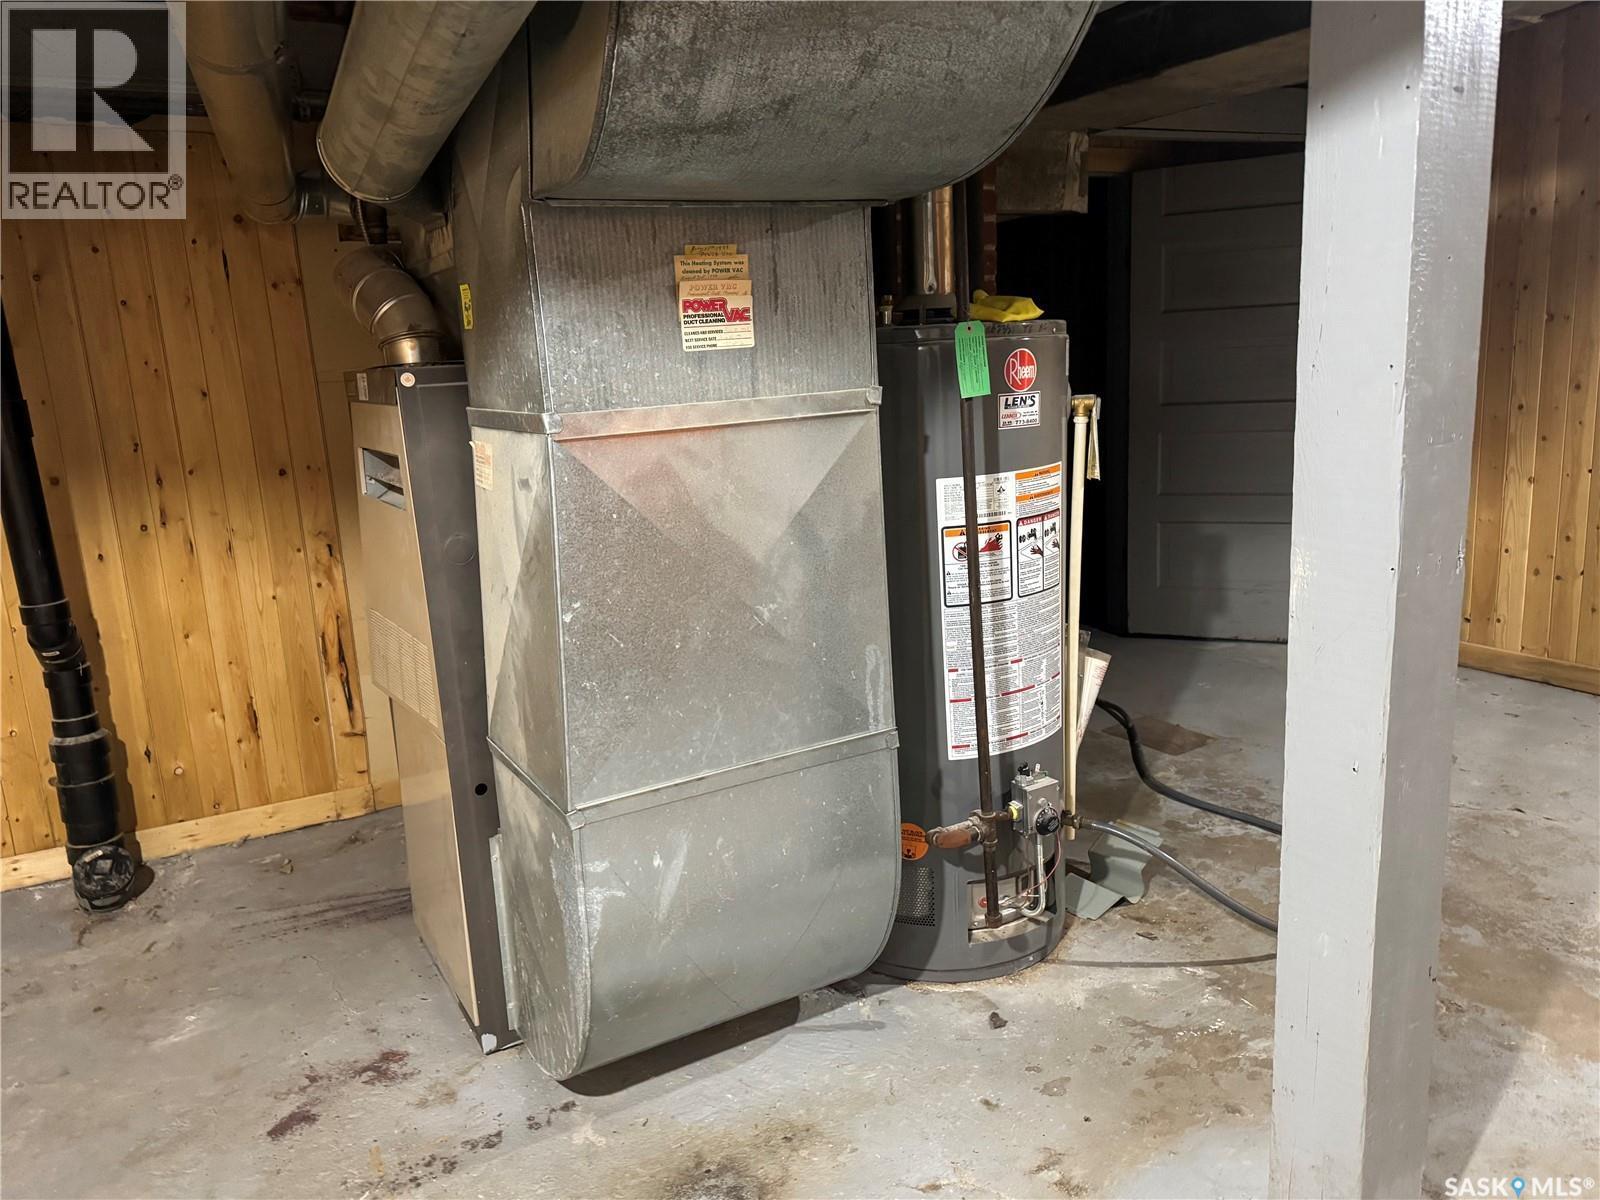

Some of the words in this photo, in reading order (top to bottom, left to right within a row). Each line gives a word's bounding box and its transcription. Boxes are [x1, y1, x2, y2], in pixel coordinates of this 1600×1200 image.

[691, 260, 712, 268] Heating
[713, 259, 732, 267] System
[682, 267, 702, 275] cleaned
[703, 267, 711, 275] by
[682, 297, 726, 314] POWER
[724, 306, 752, 322] VAC
[683, 312, 724, 320] PROFESSIONAL
[1009, 351, 1035, 386] Rheem
[1004, 395, 1036, 409] LEN'S
[1023, 516, 1042, 526] DANGER
